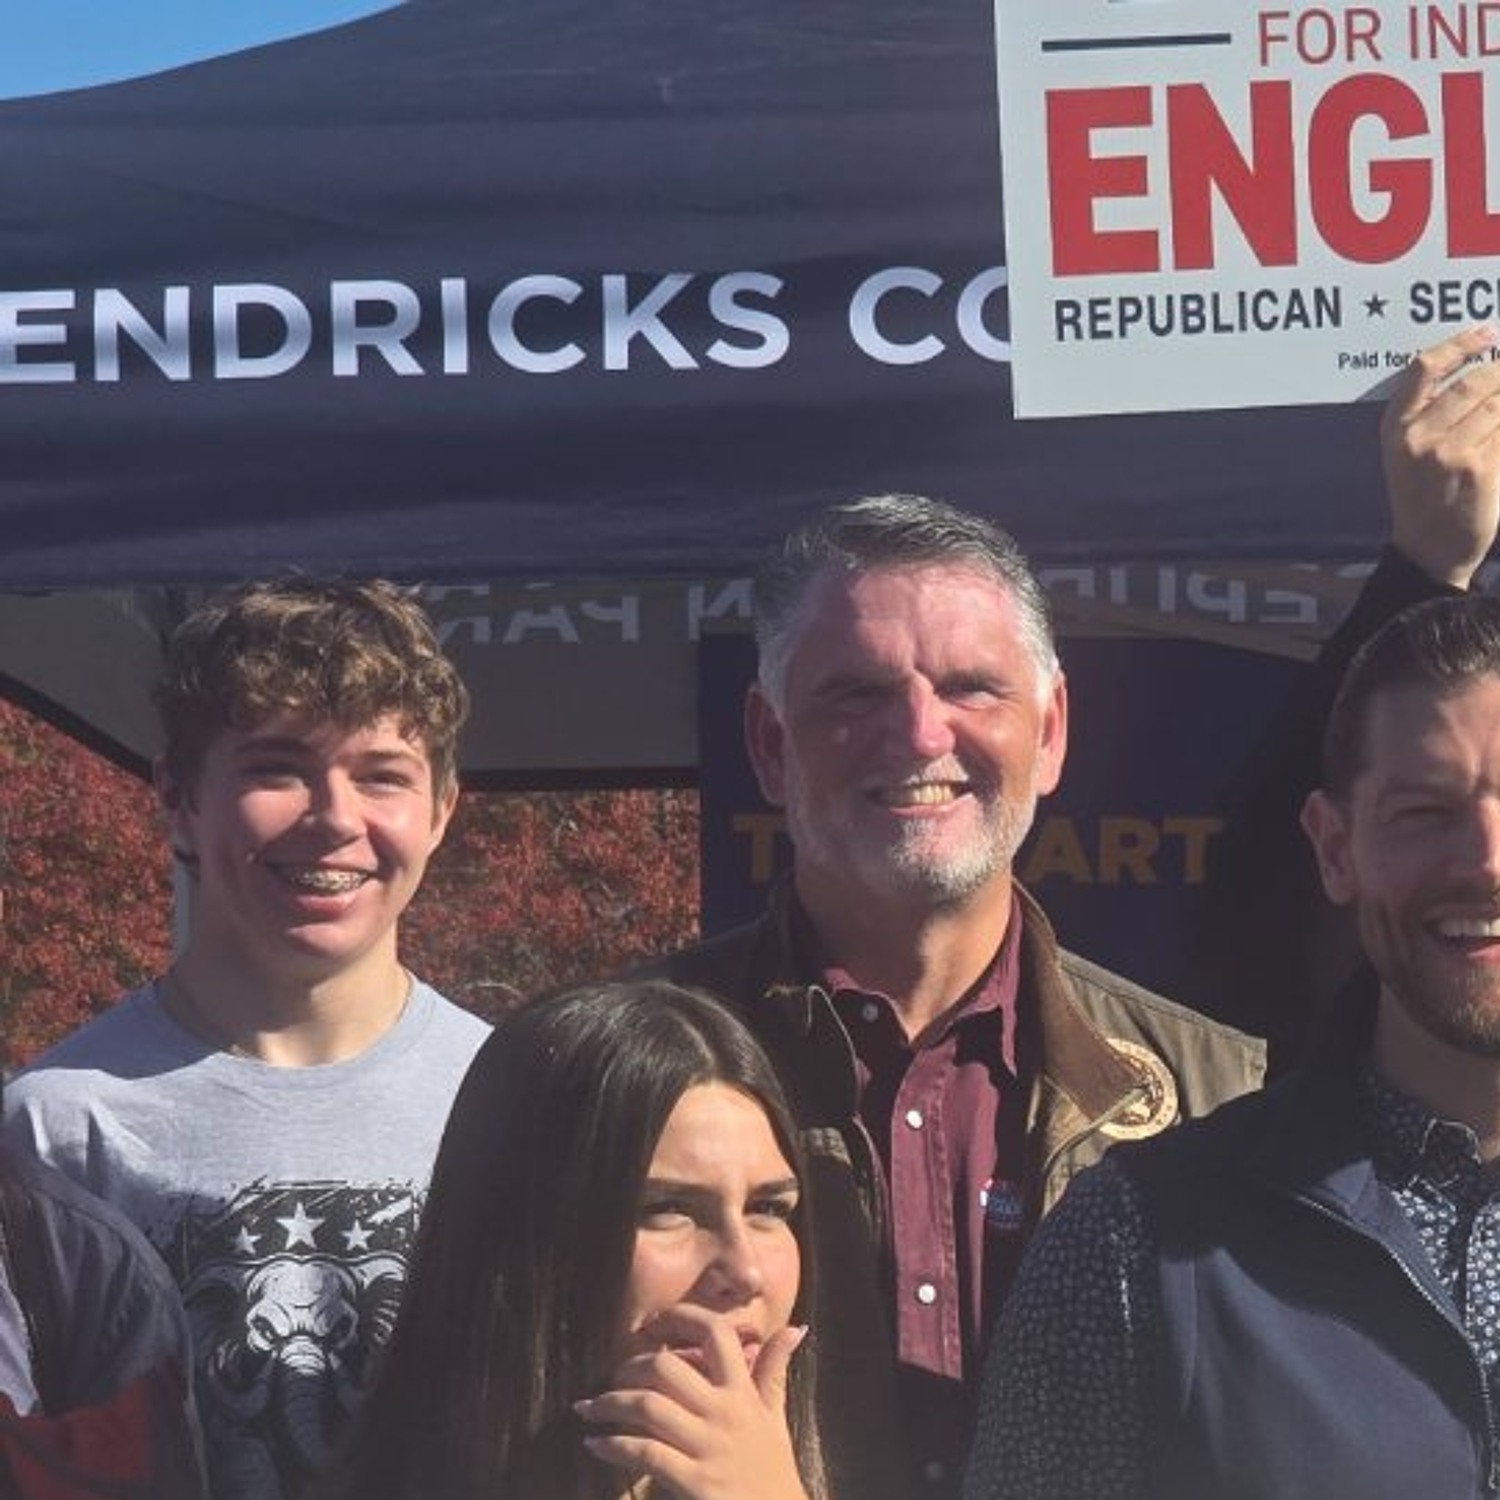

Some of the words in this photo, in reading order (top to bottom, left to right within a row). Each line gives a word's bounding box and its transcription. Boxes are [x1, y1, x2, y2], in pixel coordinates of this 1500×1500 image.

[1257, 8, 1382, 66] FOR
[1054, 286, 1343, 342] REPUBLICAN
[1337, 350, 1379, 369] Paid
